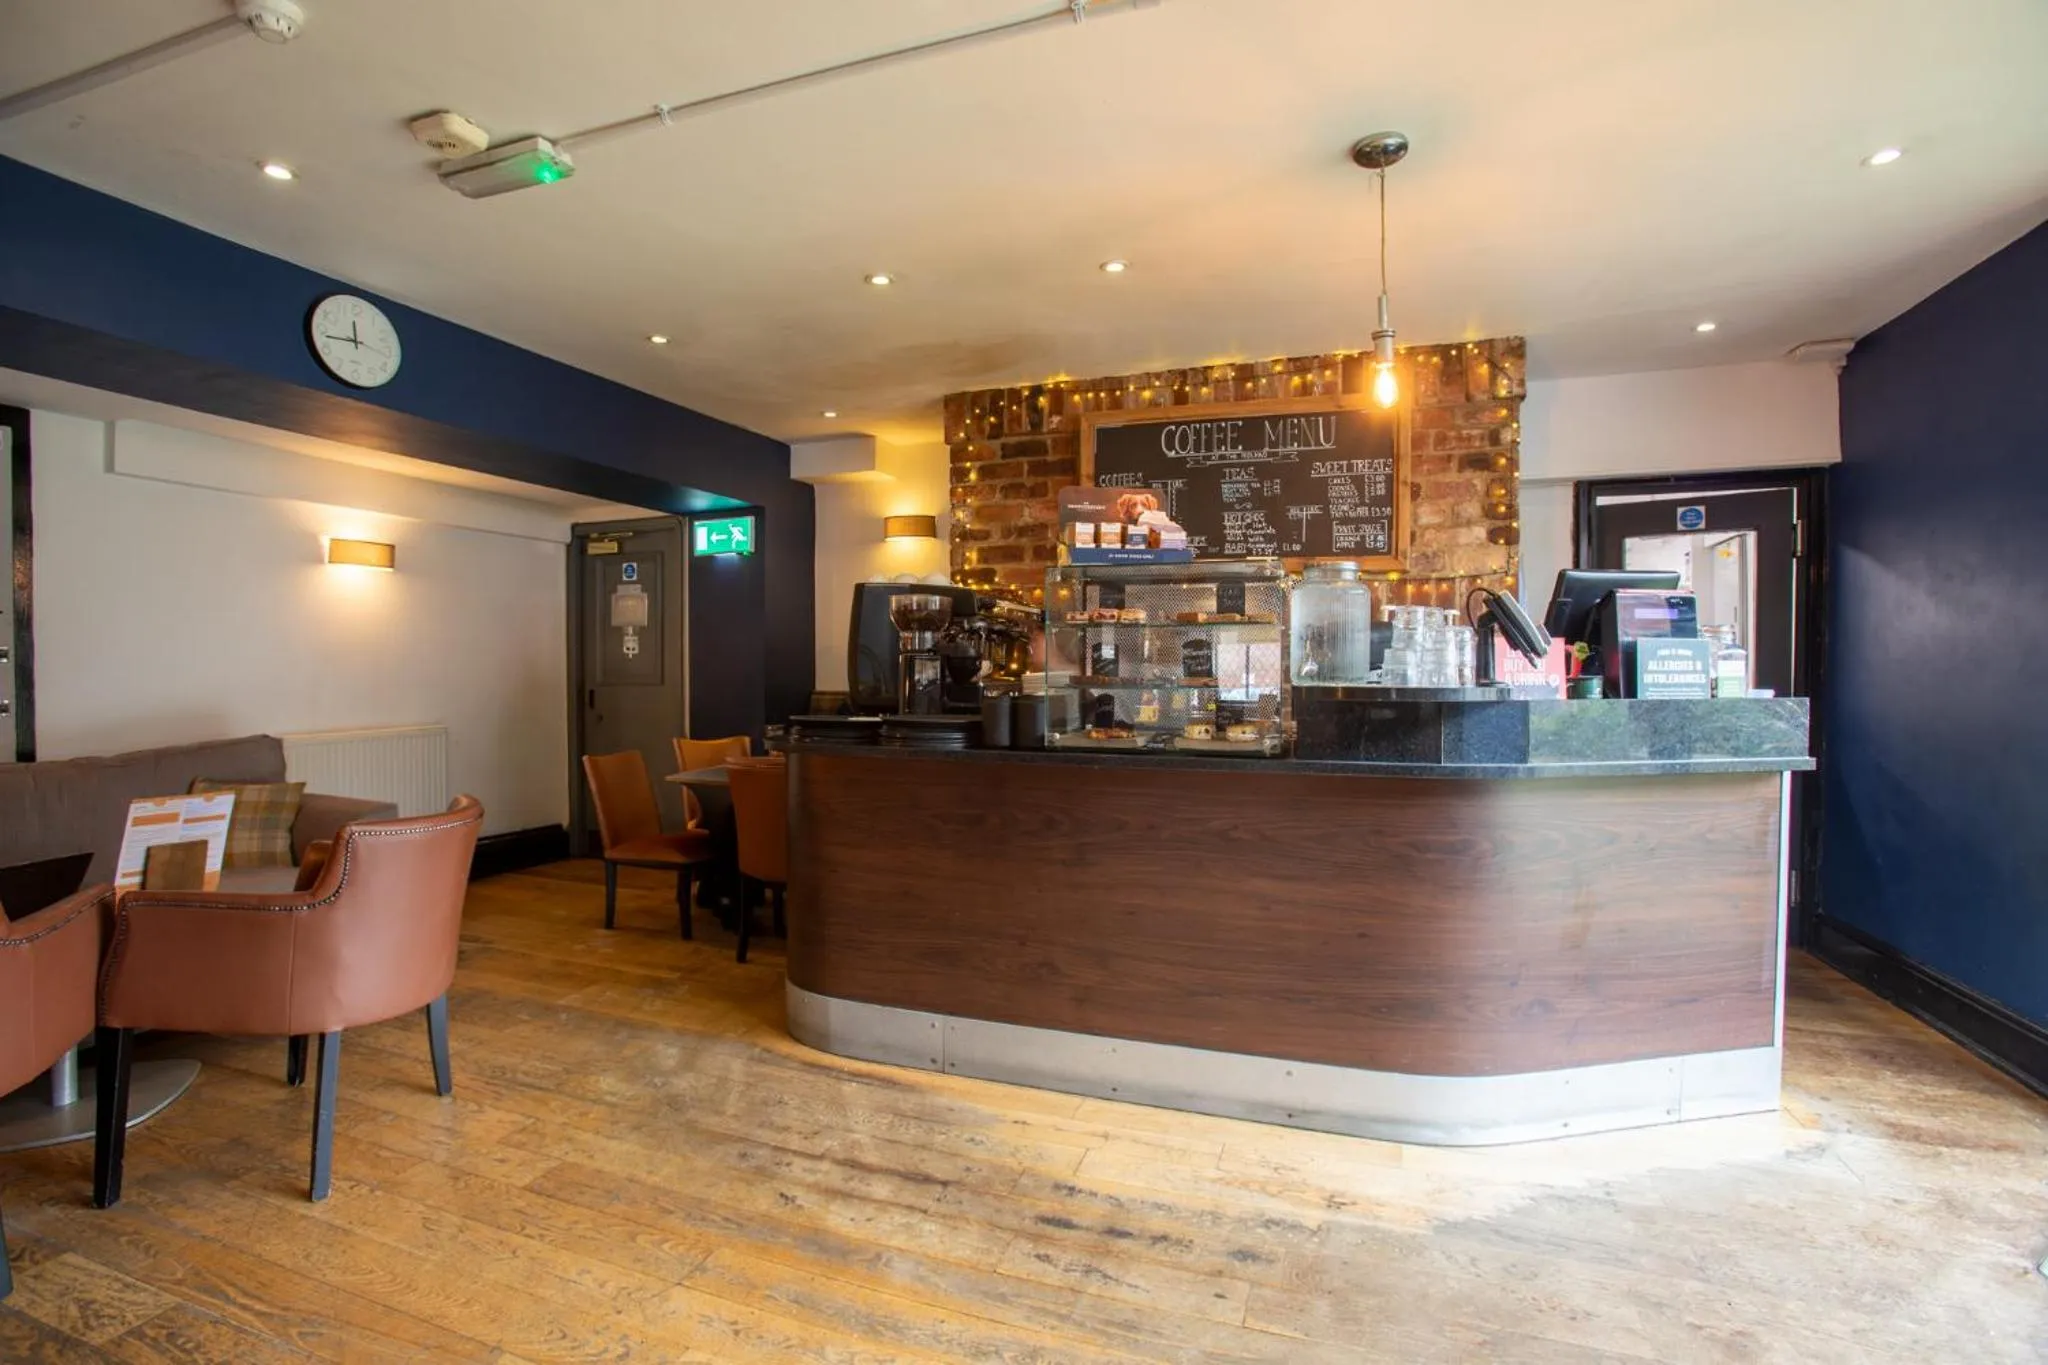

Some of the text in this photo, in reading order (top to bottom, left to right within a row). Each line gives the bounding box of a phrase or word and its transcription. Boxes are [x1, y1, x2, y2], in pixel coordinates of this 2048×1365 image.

[1161, 415, 1337, 454] COFFEE MENU
[1222, 466, 1255, 480] TEAS
[1311, 458, 1393, 475] SWEET TREATS
[1647, 660, 1694, 671] ALLERGIES
[1643, 673, 1706, 684] INTOLERANCES
